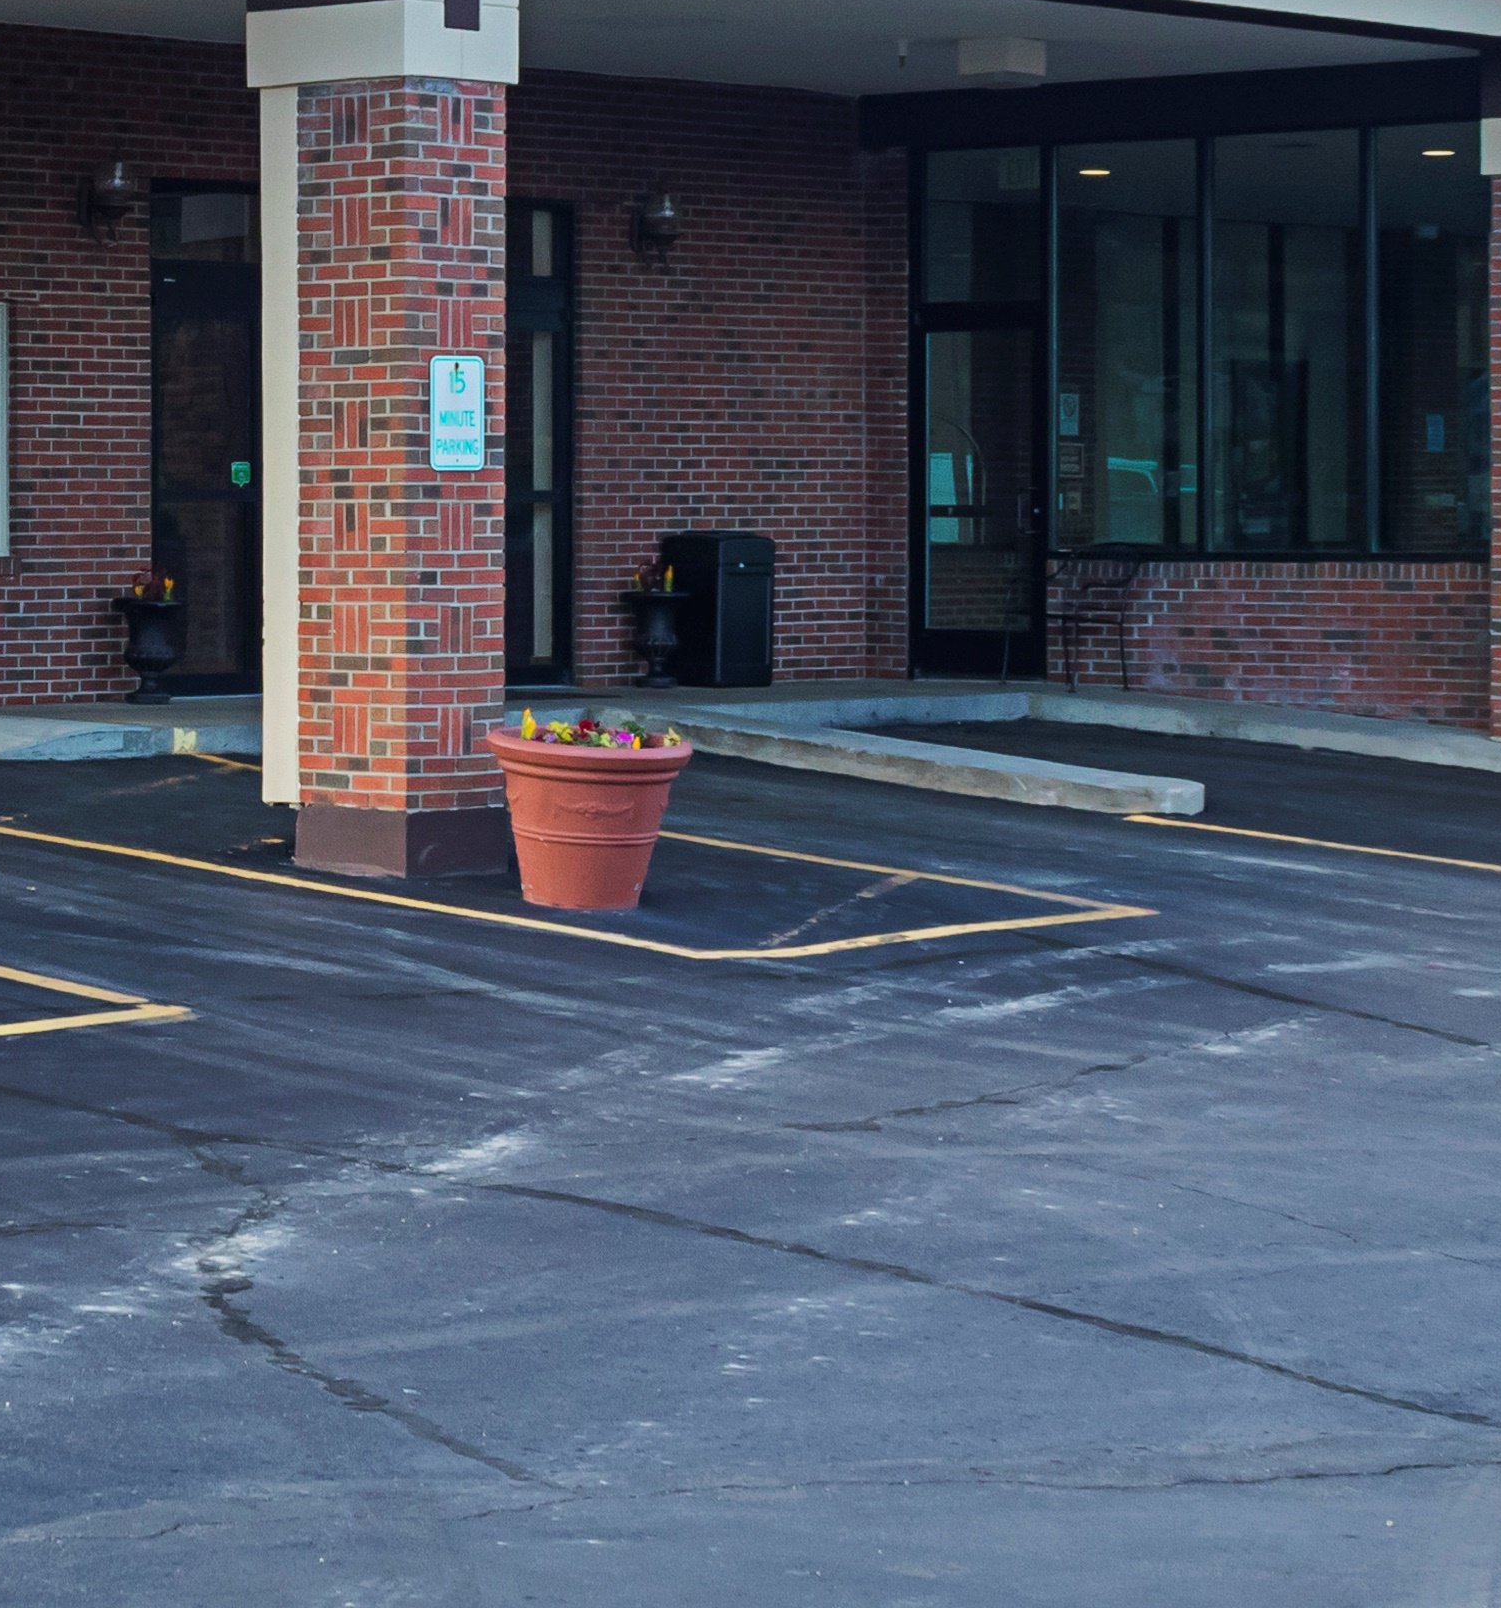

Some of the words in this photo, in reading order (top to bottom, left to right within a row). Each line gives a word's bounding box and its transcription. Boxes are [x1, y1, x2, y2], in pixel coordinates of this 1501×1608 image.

[449, 371, 466, 394] 15
[439, 410, 476, 427] MINUTE
[436, 438, 479, 455] PARKING
